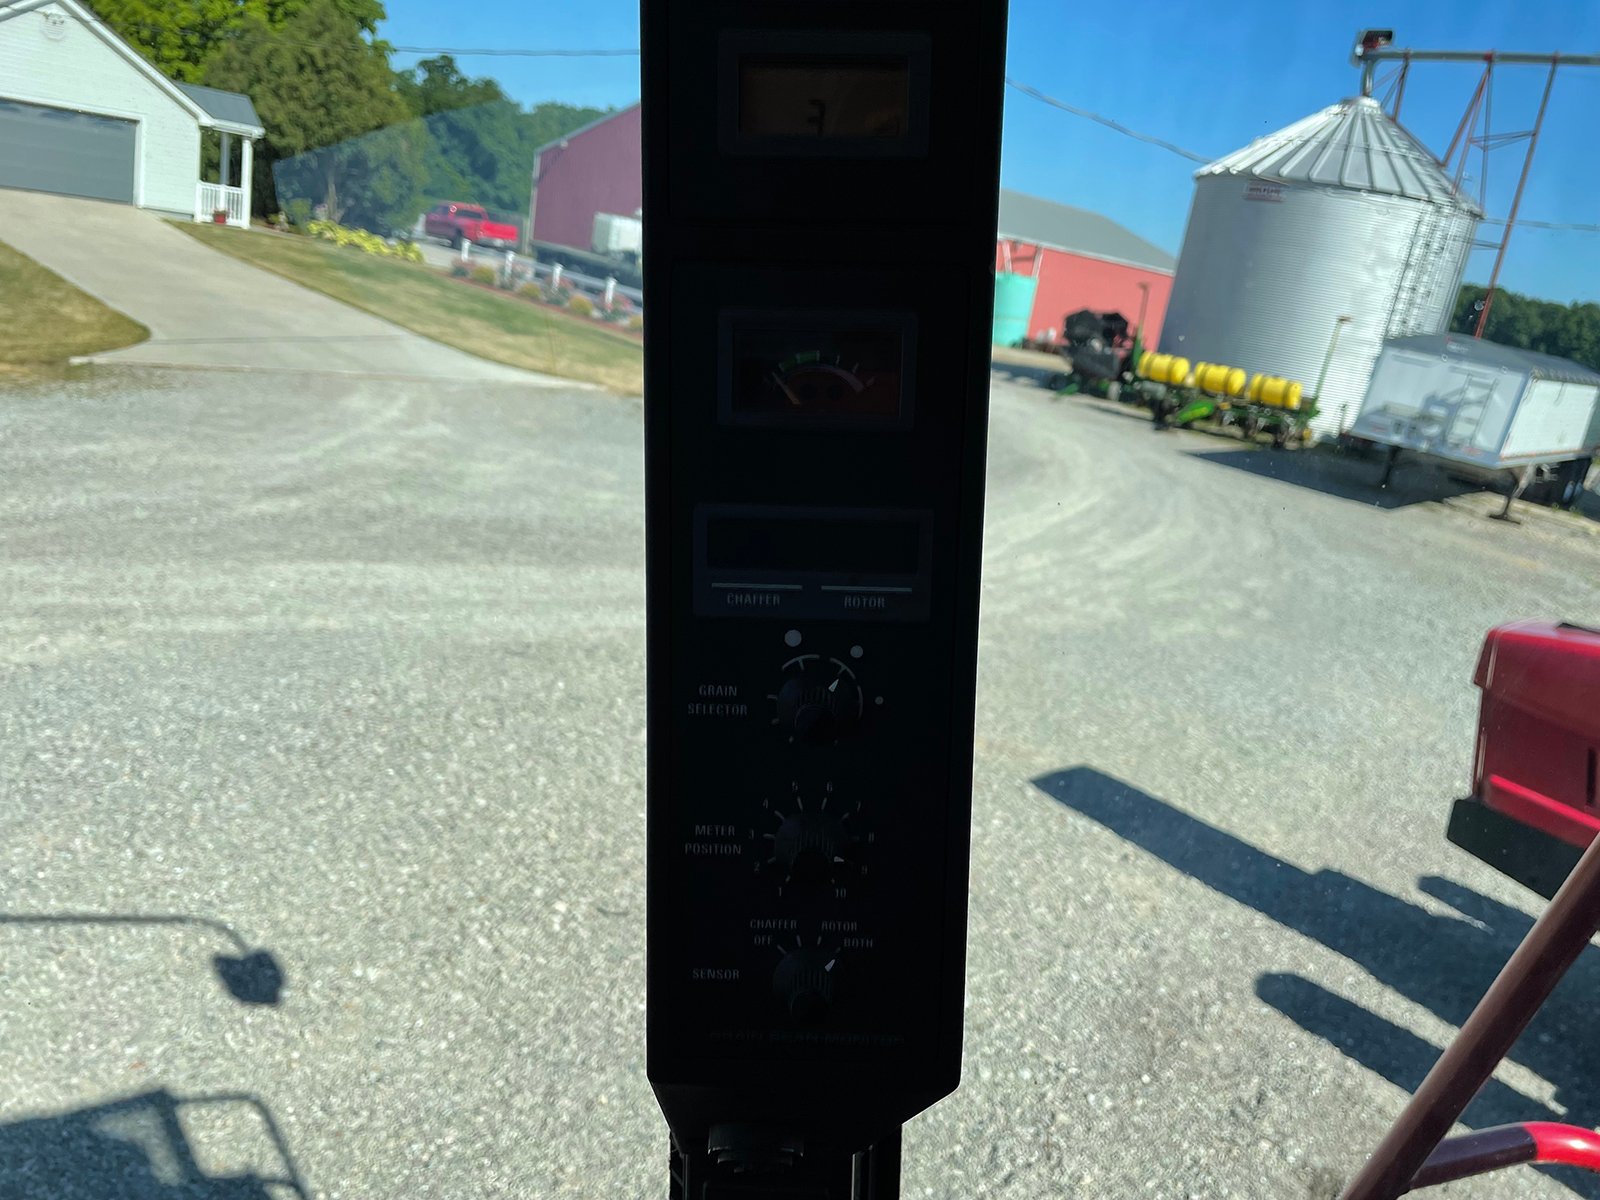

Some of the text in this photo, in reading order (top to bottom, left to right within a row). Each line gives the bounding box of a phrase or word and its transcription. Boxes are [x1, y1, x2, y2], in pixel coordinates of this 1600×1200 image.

[726, 592, 781, 607] CHAFFER
[843, 595, 886, 609] ROTOR
[698, 684, 738, 697] GRAIN
[687, 702, 748, 716] SELECTOR
[791, 781, 799, 793] 5
[826, 781, 834, 793] 6
[694, 824, 736, 837] METER
[684, 842, 742, 856] POSITION
[834, 887, 847, 899] 10
[749, 918, 798, 930] CHAFFER
[821, 920, 858, 932] ROTOR
[753, 934, 774, 946] OFF
[843, 937, 874, 949] BOTH
[692, 968, 740, 981] SENSOR
